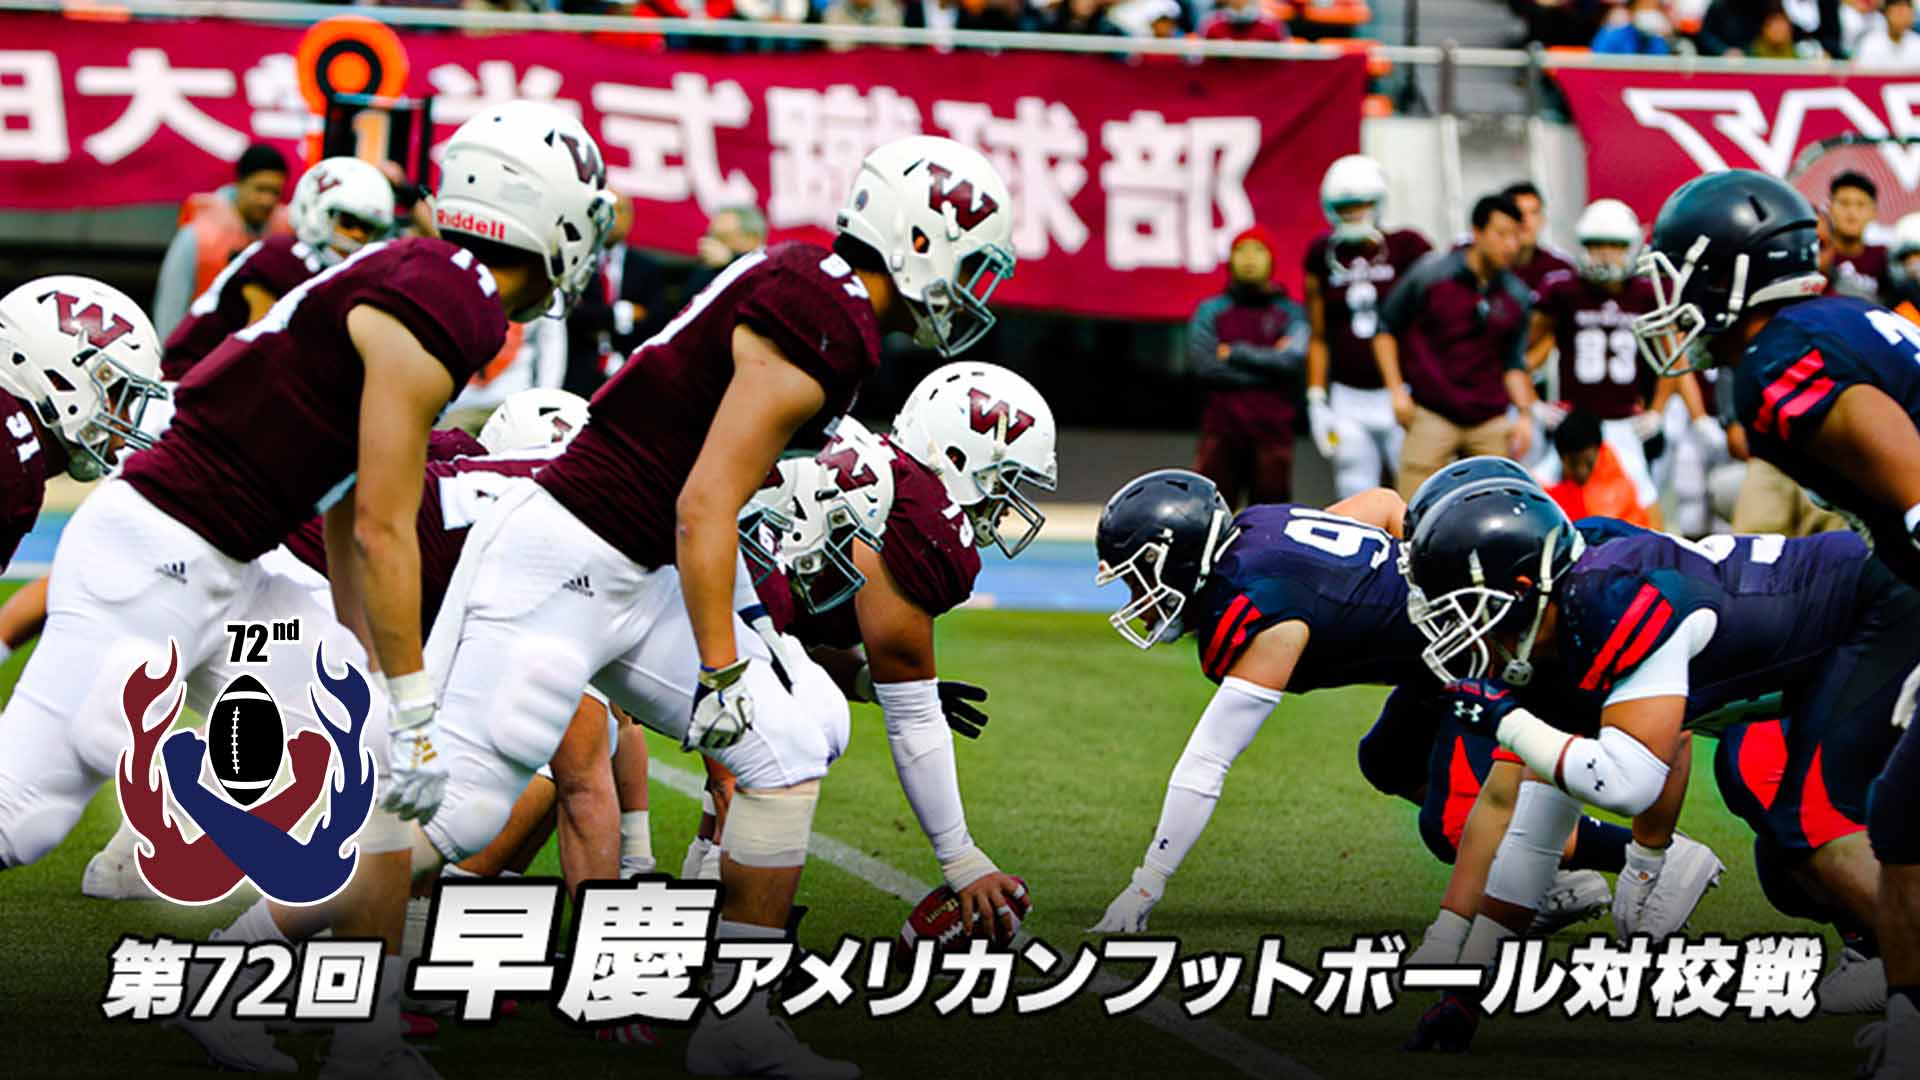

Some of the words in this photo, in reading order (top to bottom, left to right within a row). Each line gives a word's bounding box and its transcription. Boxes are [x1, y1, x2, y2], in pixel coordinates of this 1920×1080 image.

[437, 208, 506, 241] Riddell
[927, 162, 998, 231] W
[54, 290, 135, 349] W
[967, 387, 1035, 446] W
